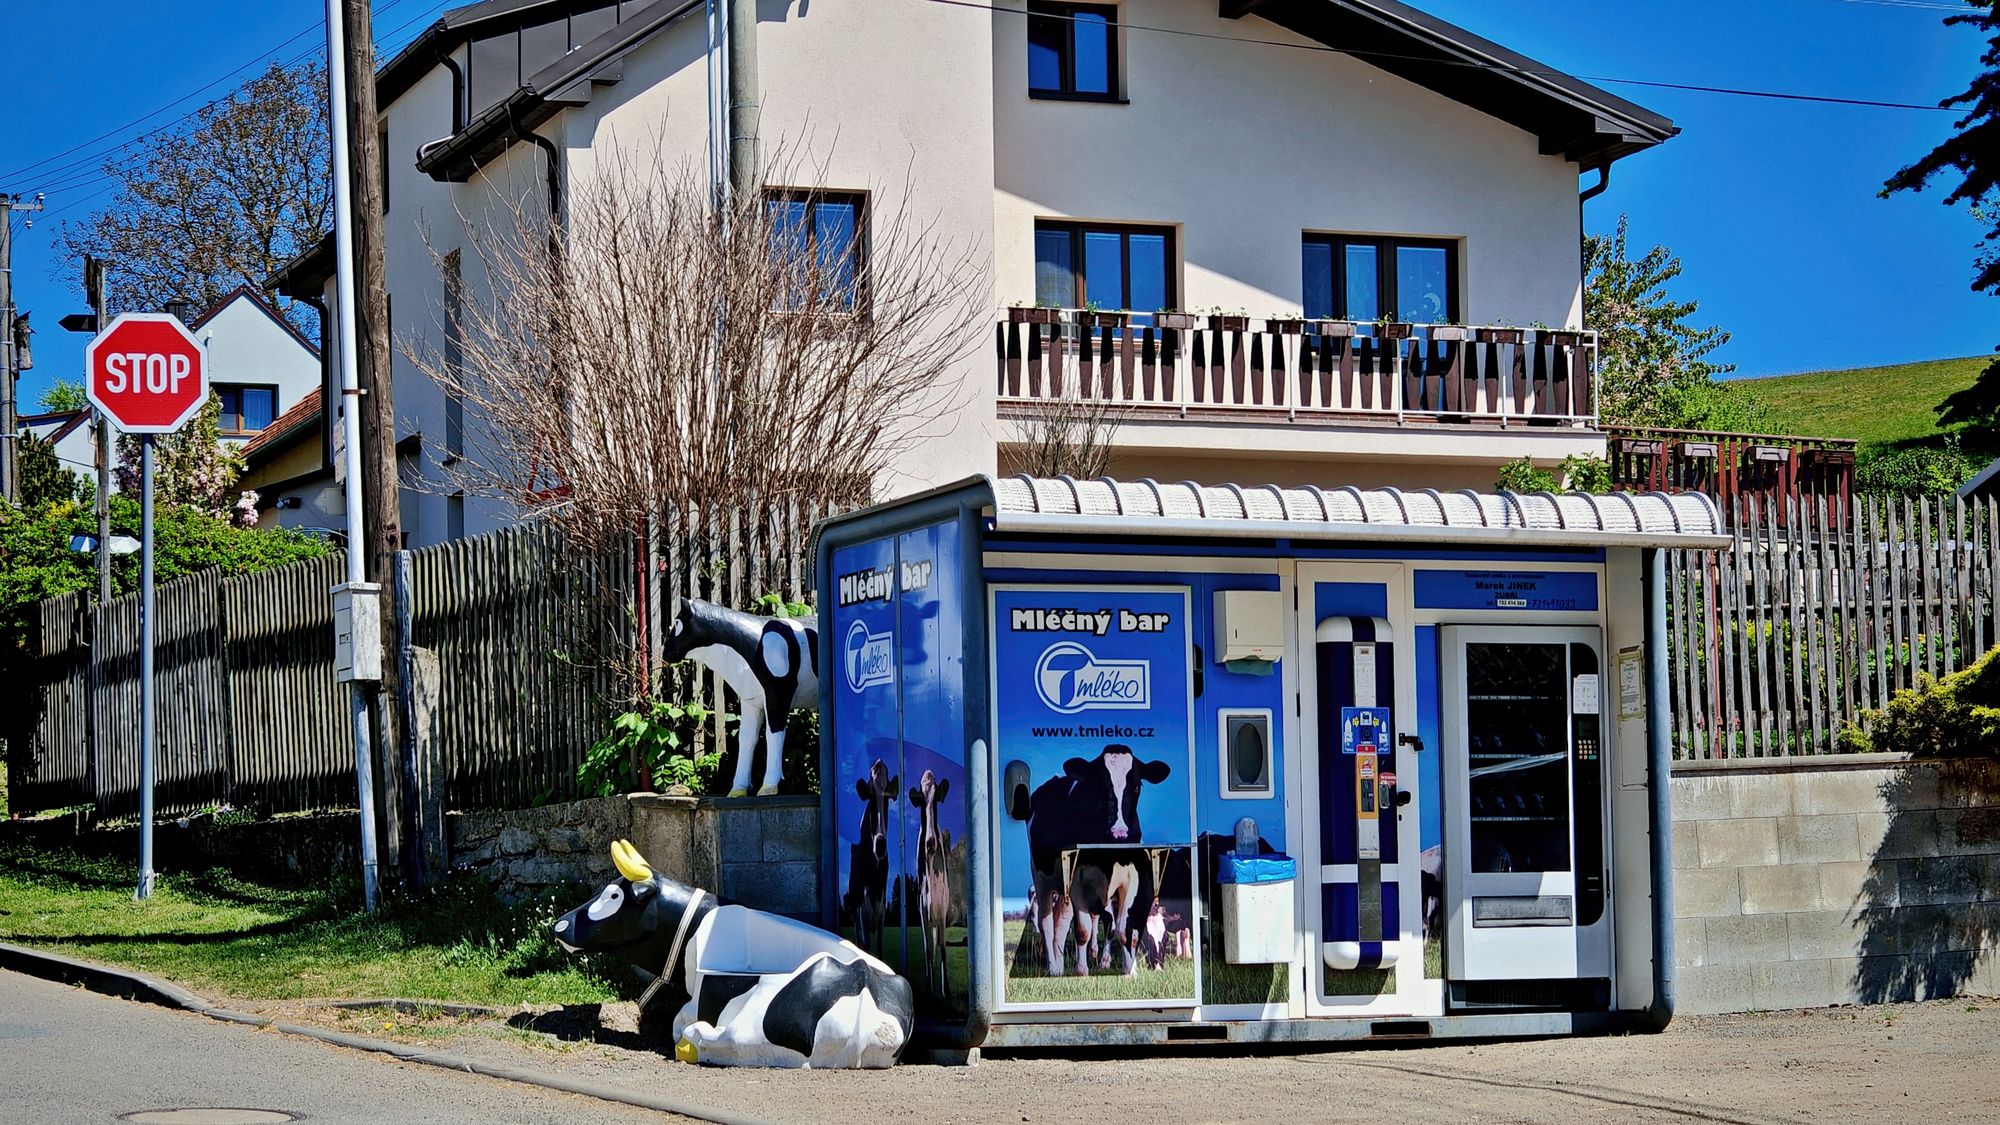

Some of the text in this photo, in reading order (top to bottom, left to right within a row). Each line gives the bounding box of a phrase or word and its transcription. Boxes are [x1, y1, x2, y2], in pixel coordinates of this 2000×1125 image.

[105, 352, 190, 394] STOP
[839, 560, 931, 605] Mléčný bar
[1475, 581, 1536, 591] Marek JINEK
[1012, 608, 1169, 635] Mléčný bar
[1032, 725, 1154, 738] www.tmleko.cz
